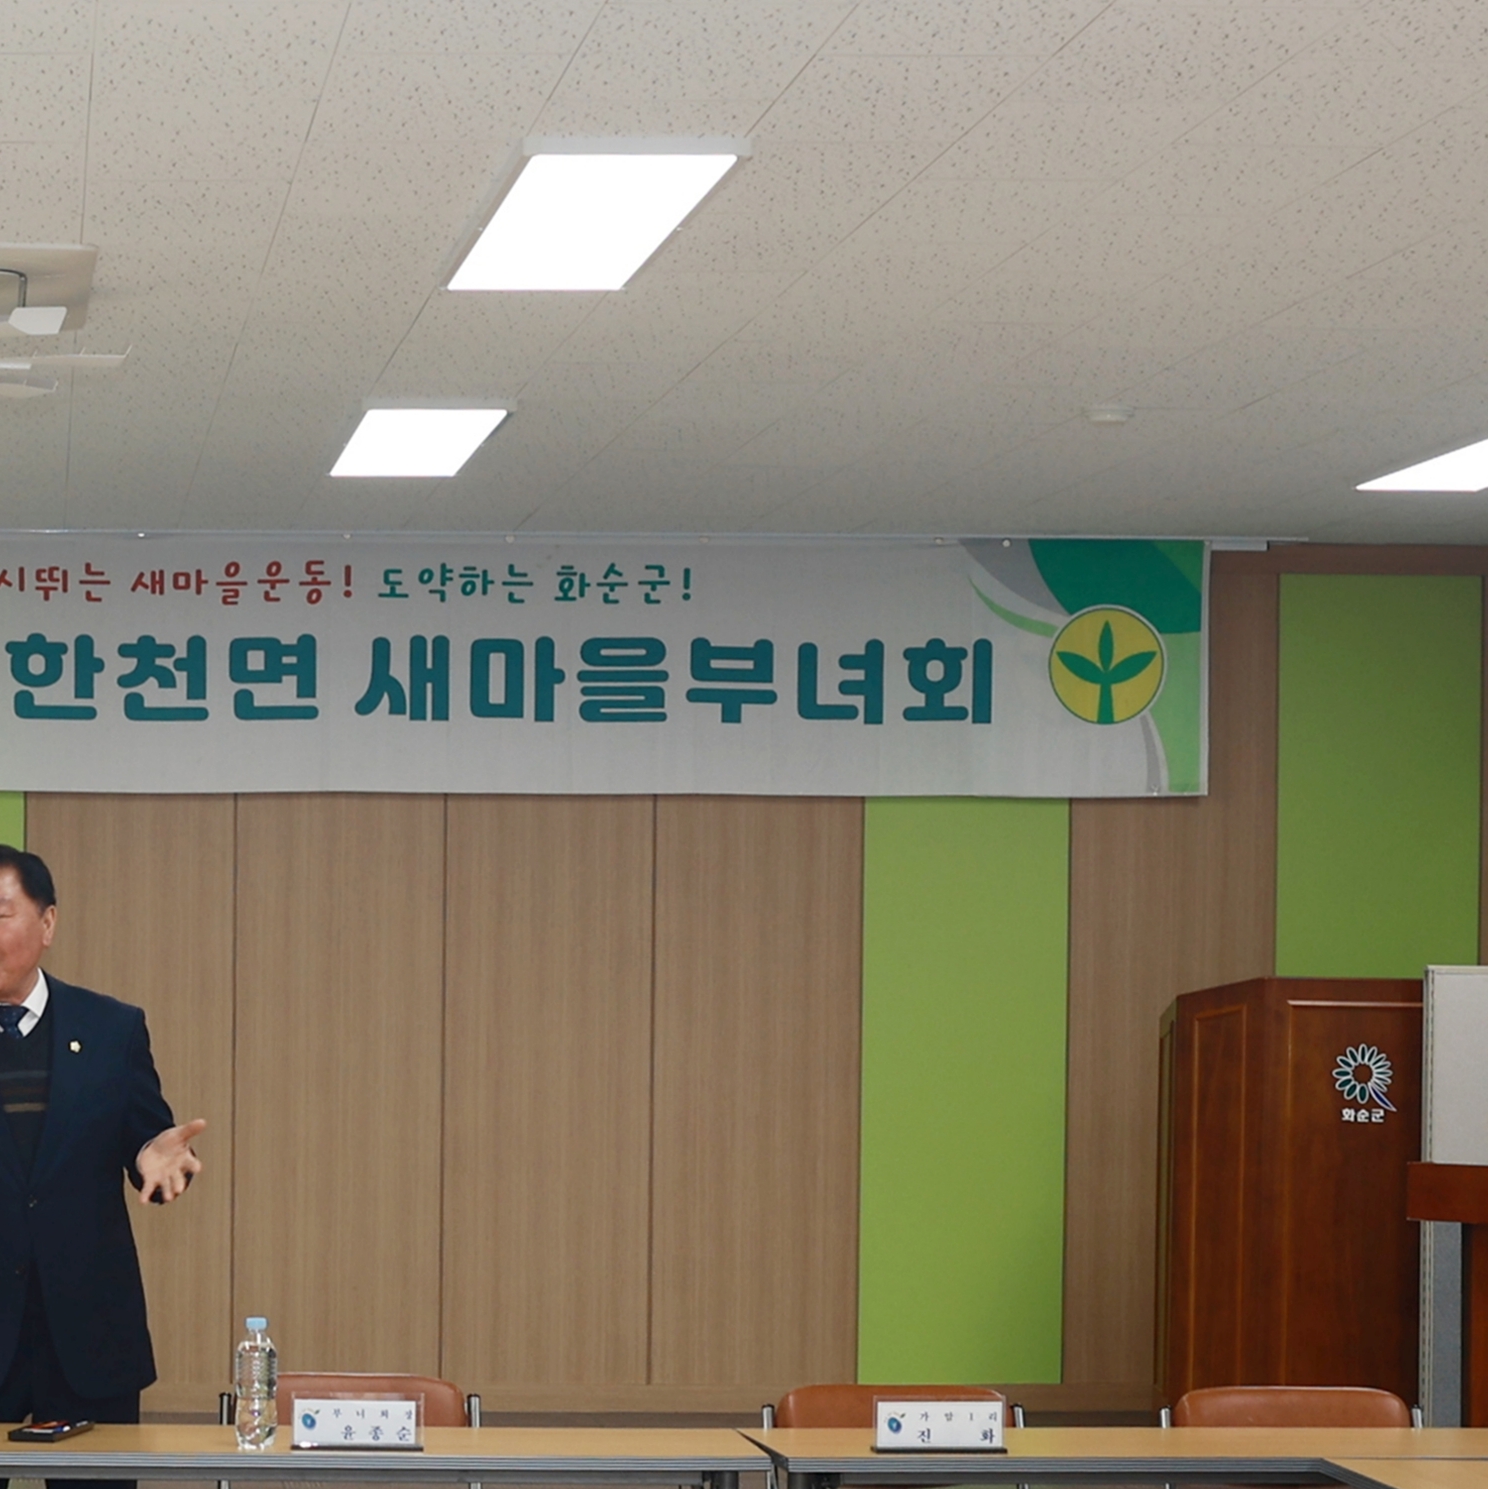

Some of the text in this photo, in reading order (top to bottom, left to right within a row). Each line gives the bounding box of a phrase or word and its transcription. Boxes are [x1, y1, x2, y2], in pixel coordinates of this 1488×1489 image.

[130, 560, 353, 605] 새마을운동!
[378, 563, 534, 604] 도약하는
[554, 563, 692, 604] 화순군!
[5, 633, 319, 721] 한천면
[354, 634, 993, 725] 새마을부녀회
[1341, 1107, 1384, 1123] 화순군
